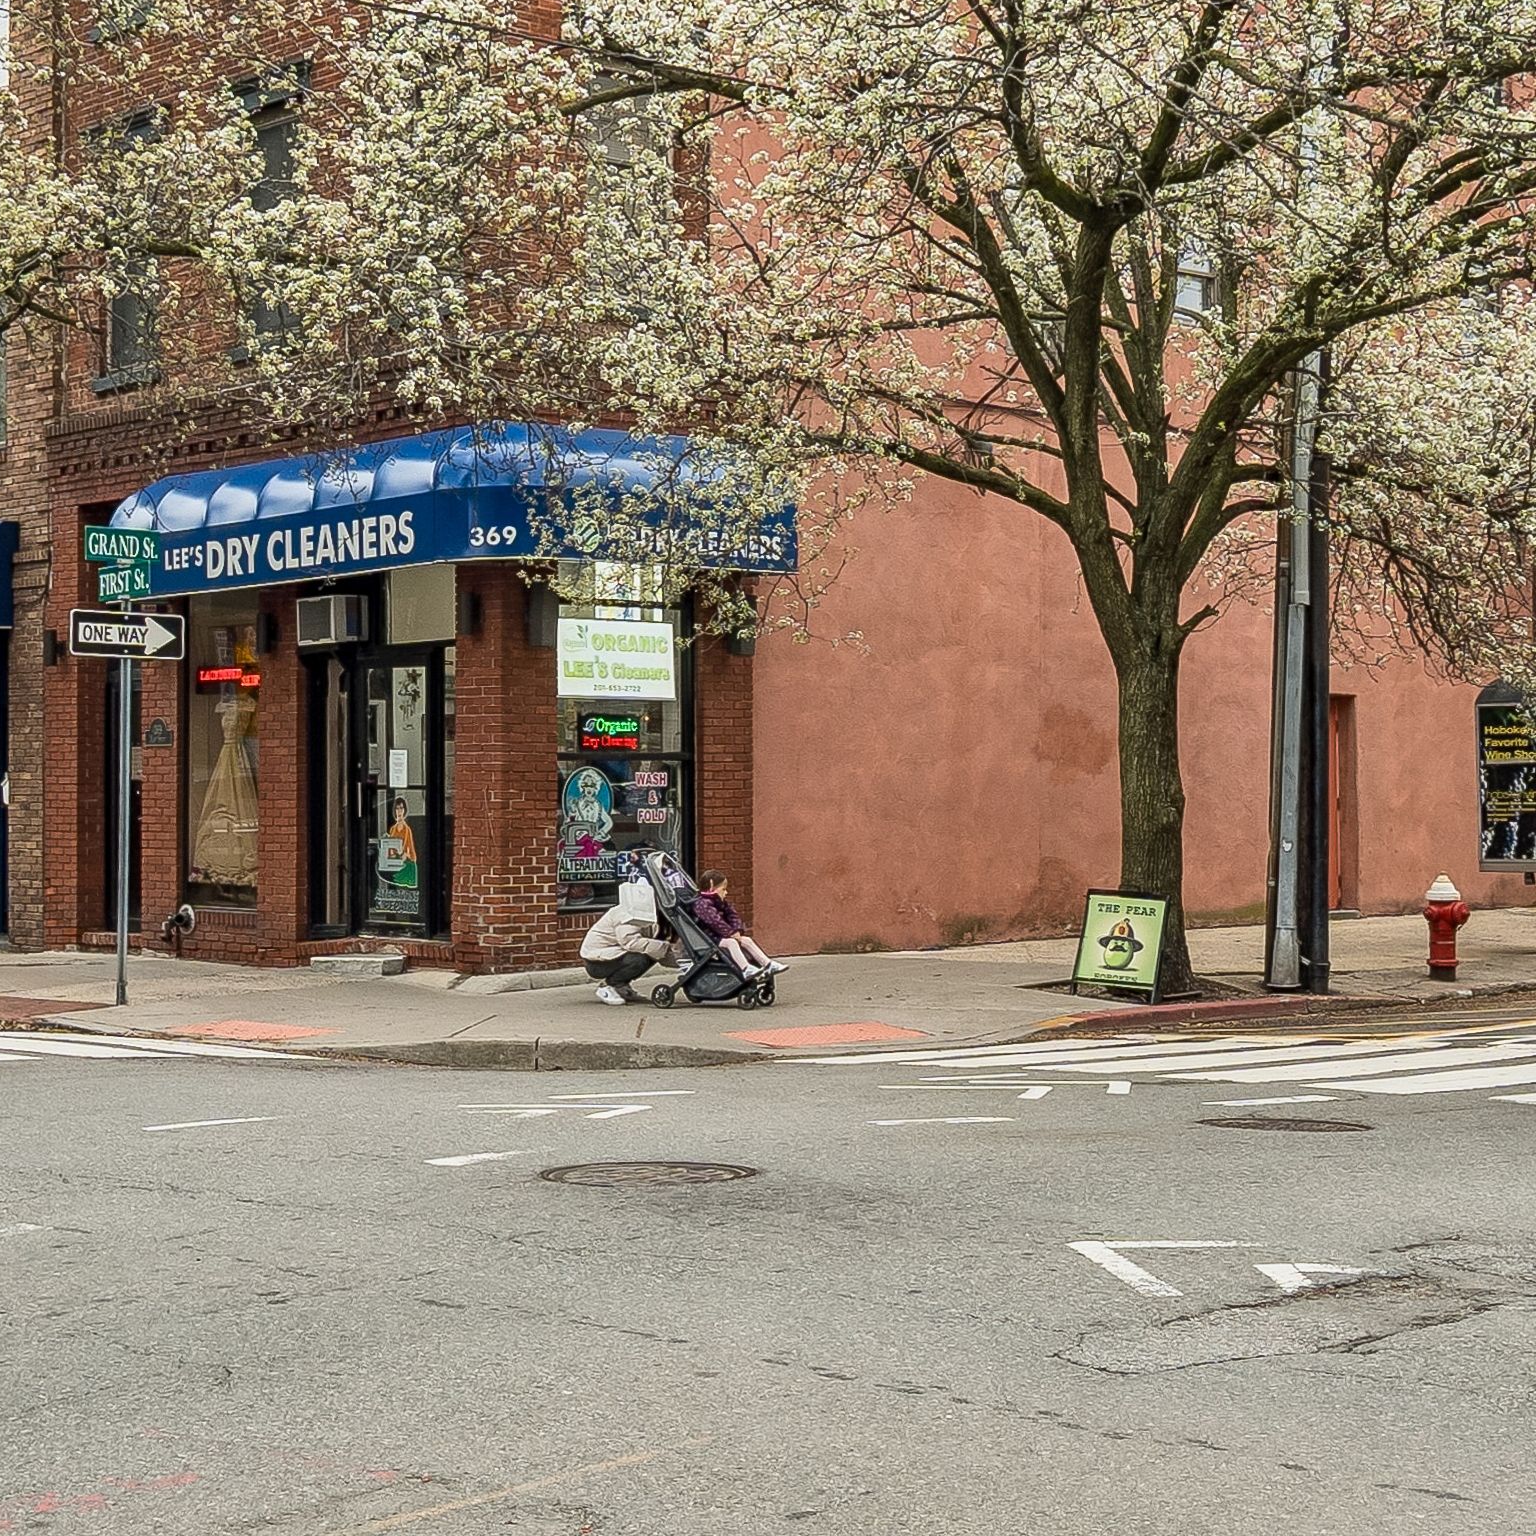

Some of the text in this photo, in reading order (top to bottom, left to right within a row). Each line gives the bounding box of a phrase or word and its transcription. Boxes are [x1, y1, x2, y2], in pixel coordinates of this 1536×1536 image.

[164, 510, 416, 579] LEE'S DRY CLEANERS
[469, 525, 518, 547] 369
[88, 532, 159, 560] GRAND St.
[98, 568, 150, 597] FIRST St.
[82, 624, 149, 644] ONE WAY
[591, 633, 669, 654] ORGANIC
[563, 655, 671, 681] LEE'S Cleaners
[596, 717, 639, 736] Organic
[1485, 737, 1529, 747] Favorite
[1485, 750, 1512, 761] Wine
[635, 771, 668, 787] WASH
[648, 790, 659, 805] &
[637, 808, 667, 824] FOLD
[559, 858, 615, 871] ALTERATIONS
[561, 872, 615, 880] REPAIRS
[1097, 902, 1157, 917] THE PEAR
